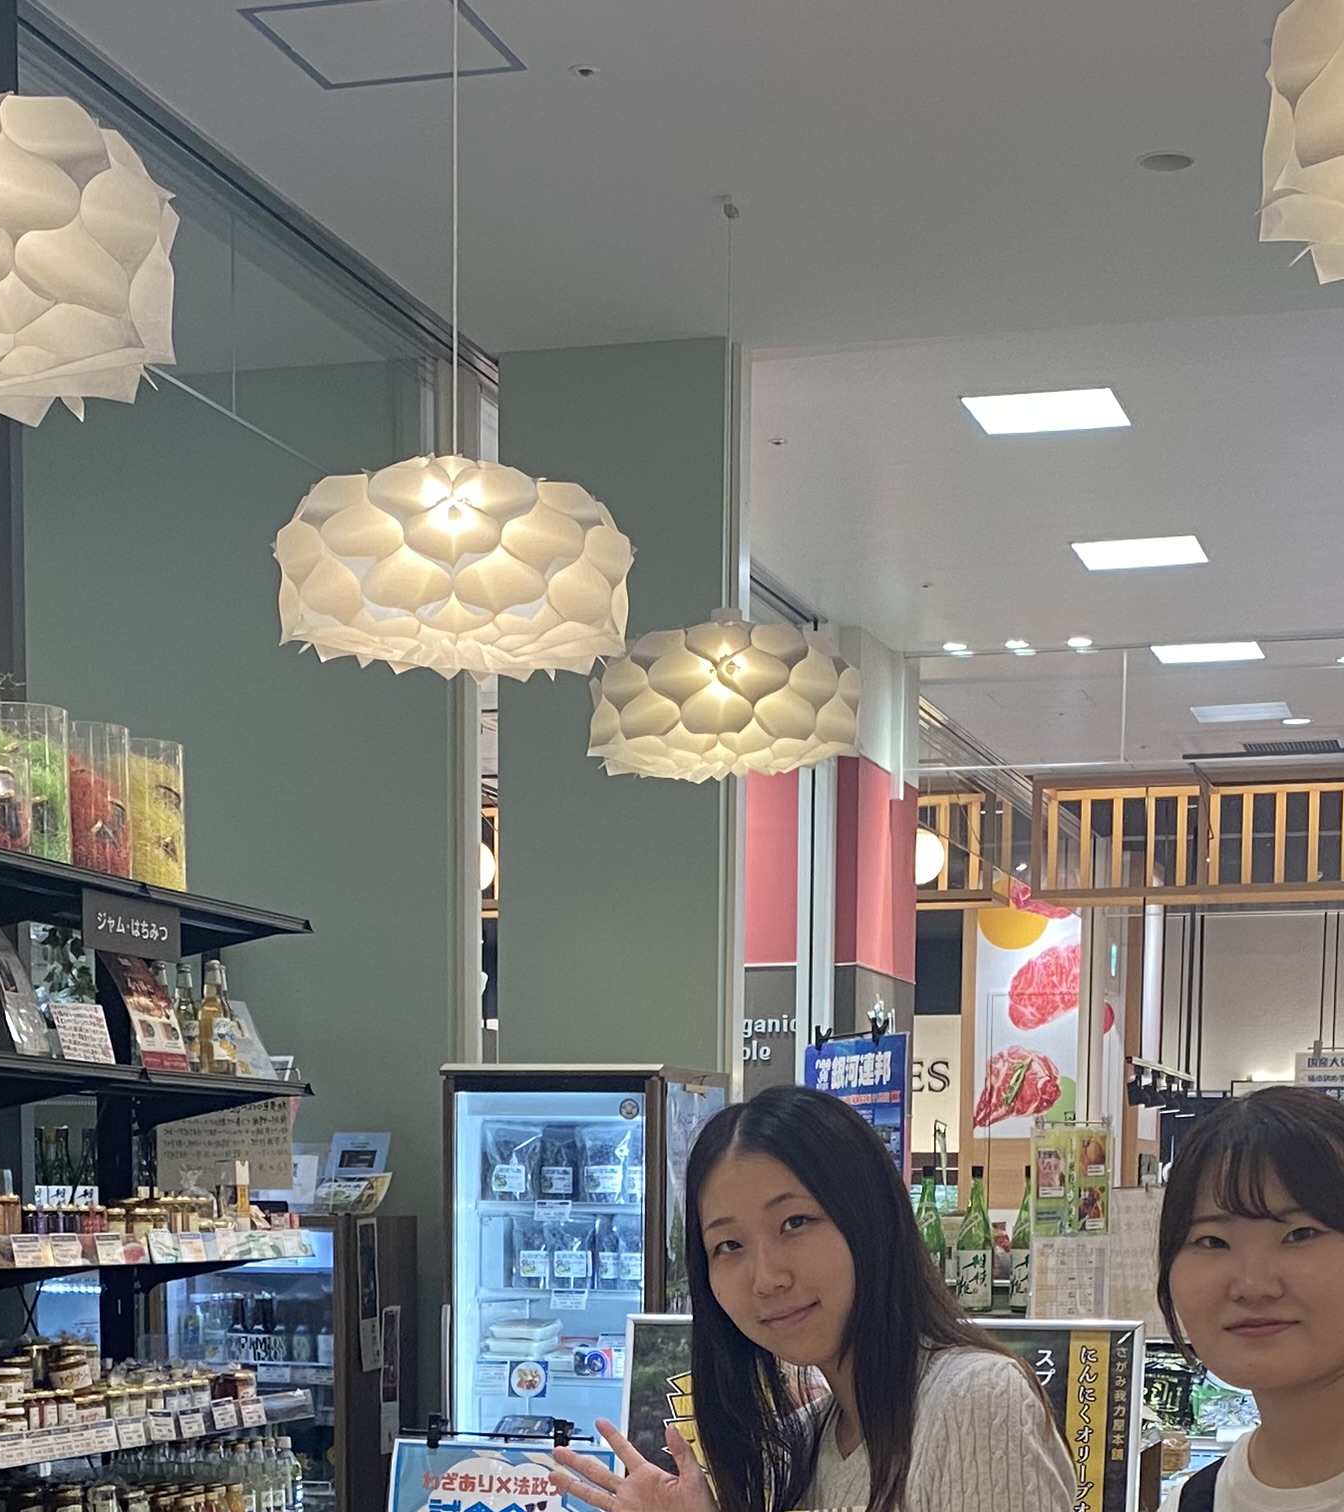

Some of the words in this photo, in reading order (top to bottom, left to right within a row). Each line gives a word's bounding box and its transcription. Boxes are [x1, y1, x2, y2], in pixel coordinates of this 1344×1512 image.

[96, 911, 169, 942] ジャム・はちみつ
[830, 1050, 892, 1091] 銀河連邦
